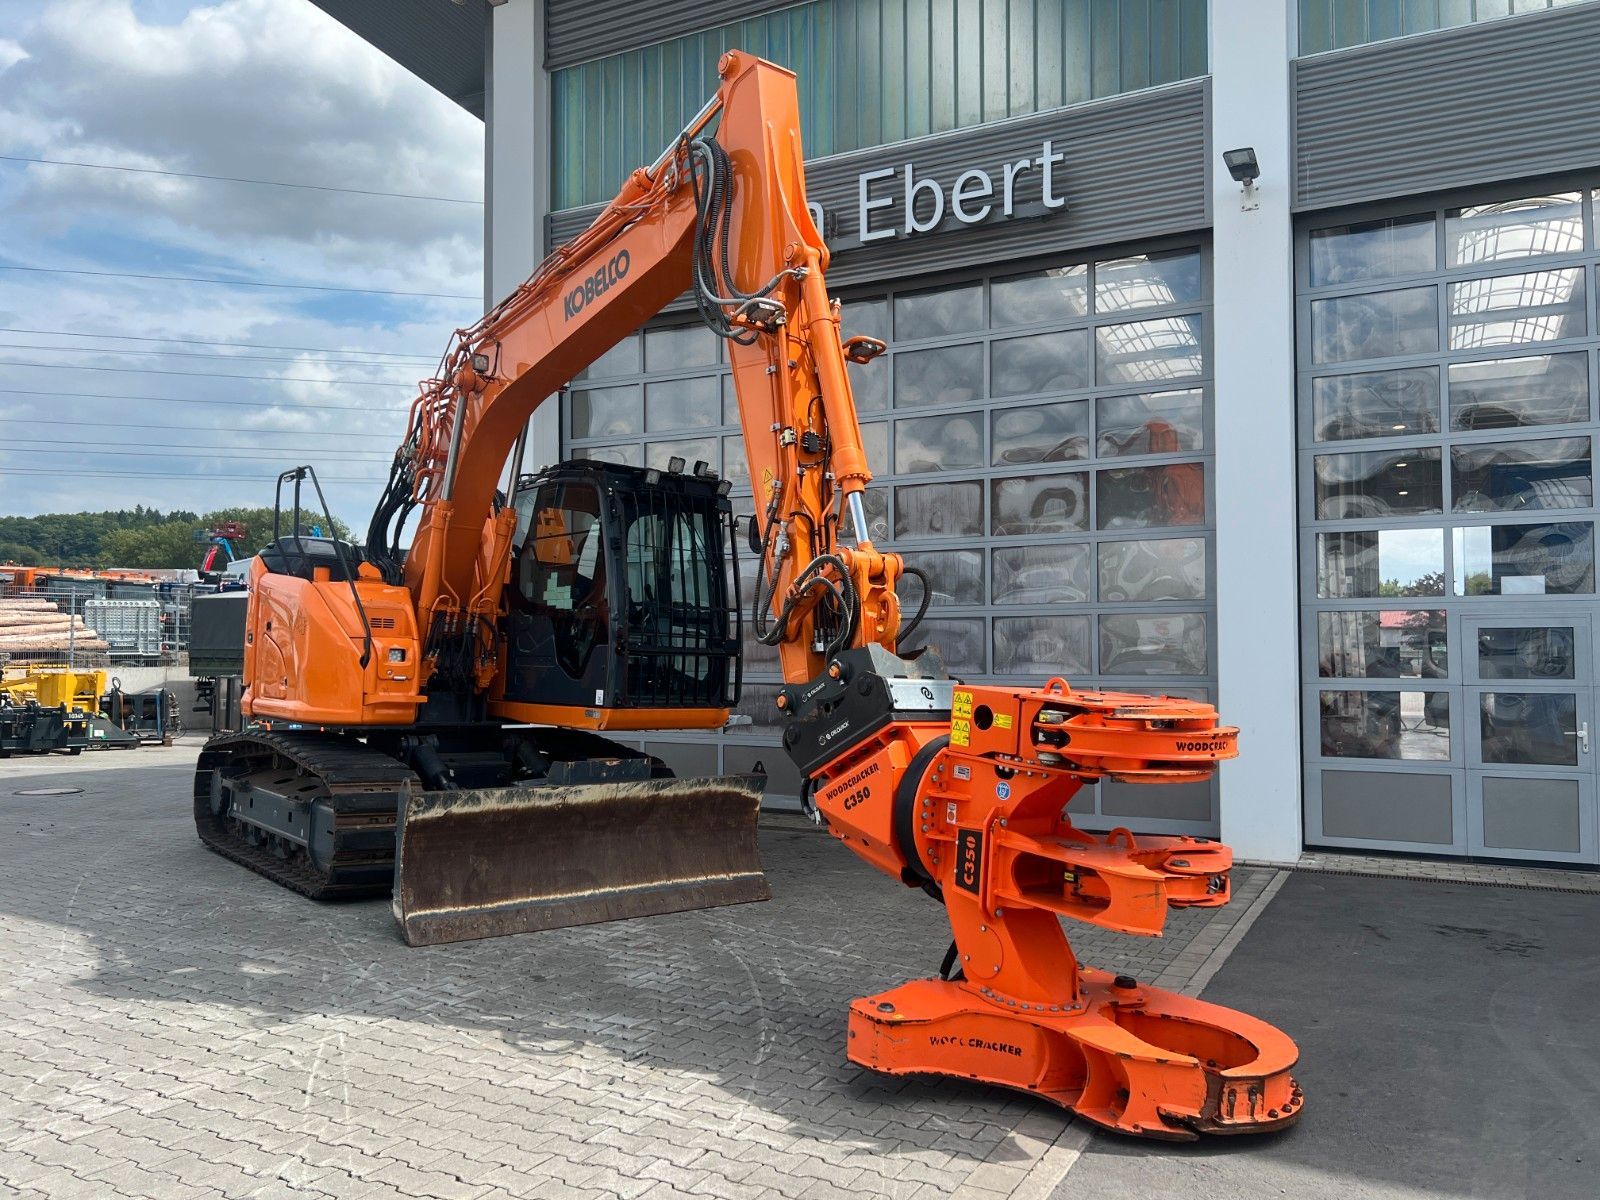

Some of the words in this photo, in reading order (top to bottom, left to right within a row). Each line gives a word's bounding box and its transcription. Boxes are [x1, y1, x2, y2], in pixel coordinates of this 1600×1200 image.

[859, 140, 1066, 243] Ebert
[563, 249, 631, 323] KOBELCO
[826, 762, 880, 801] WOODCRACKER
[843, 786, 871, 811] C350
[963, 835, 976, 886] C350
